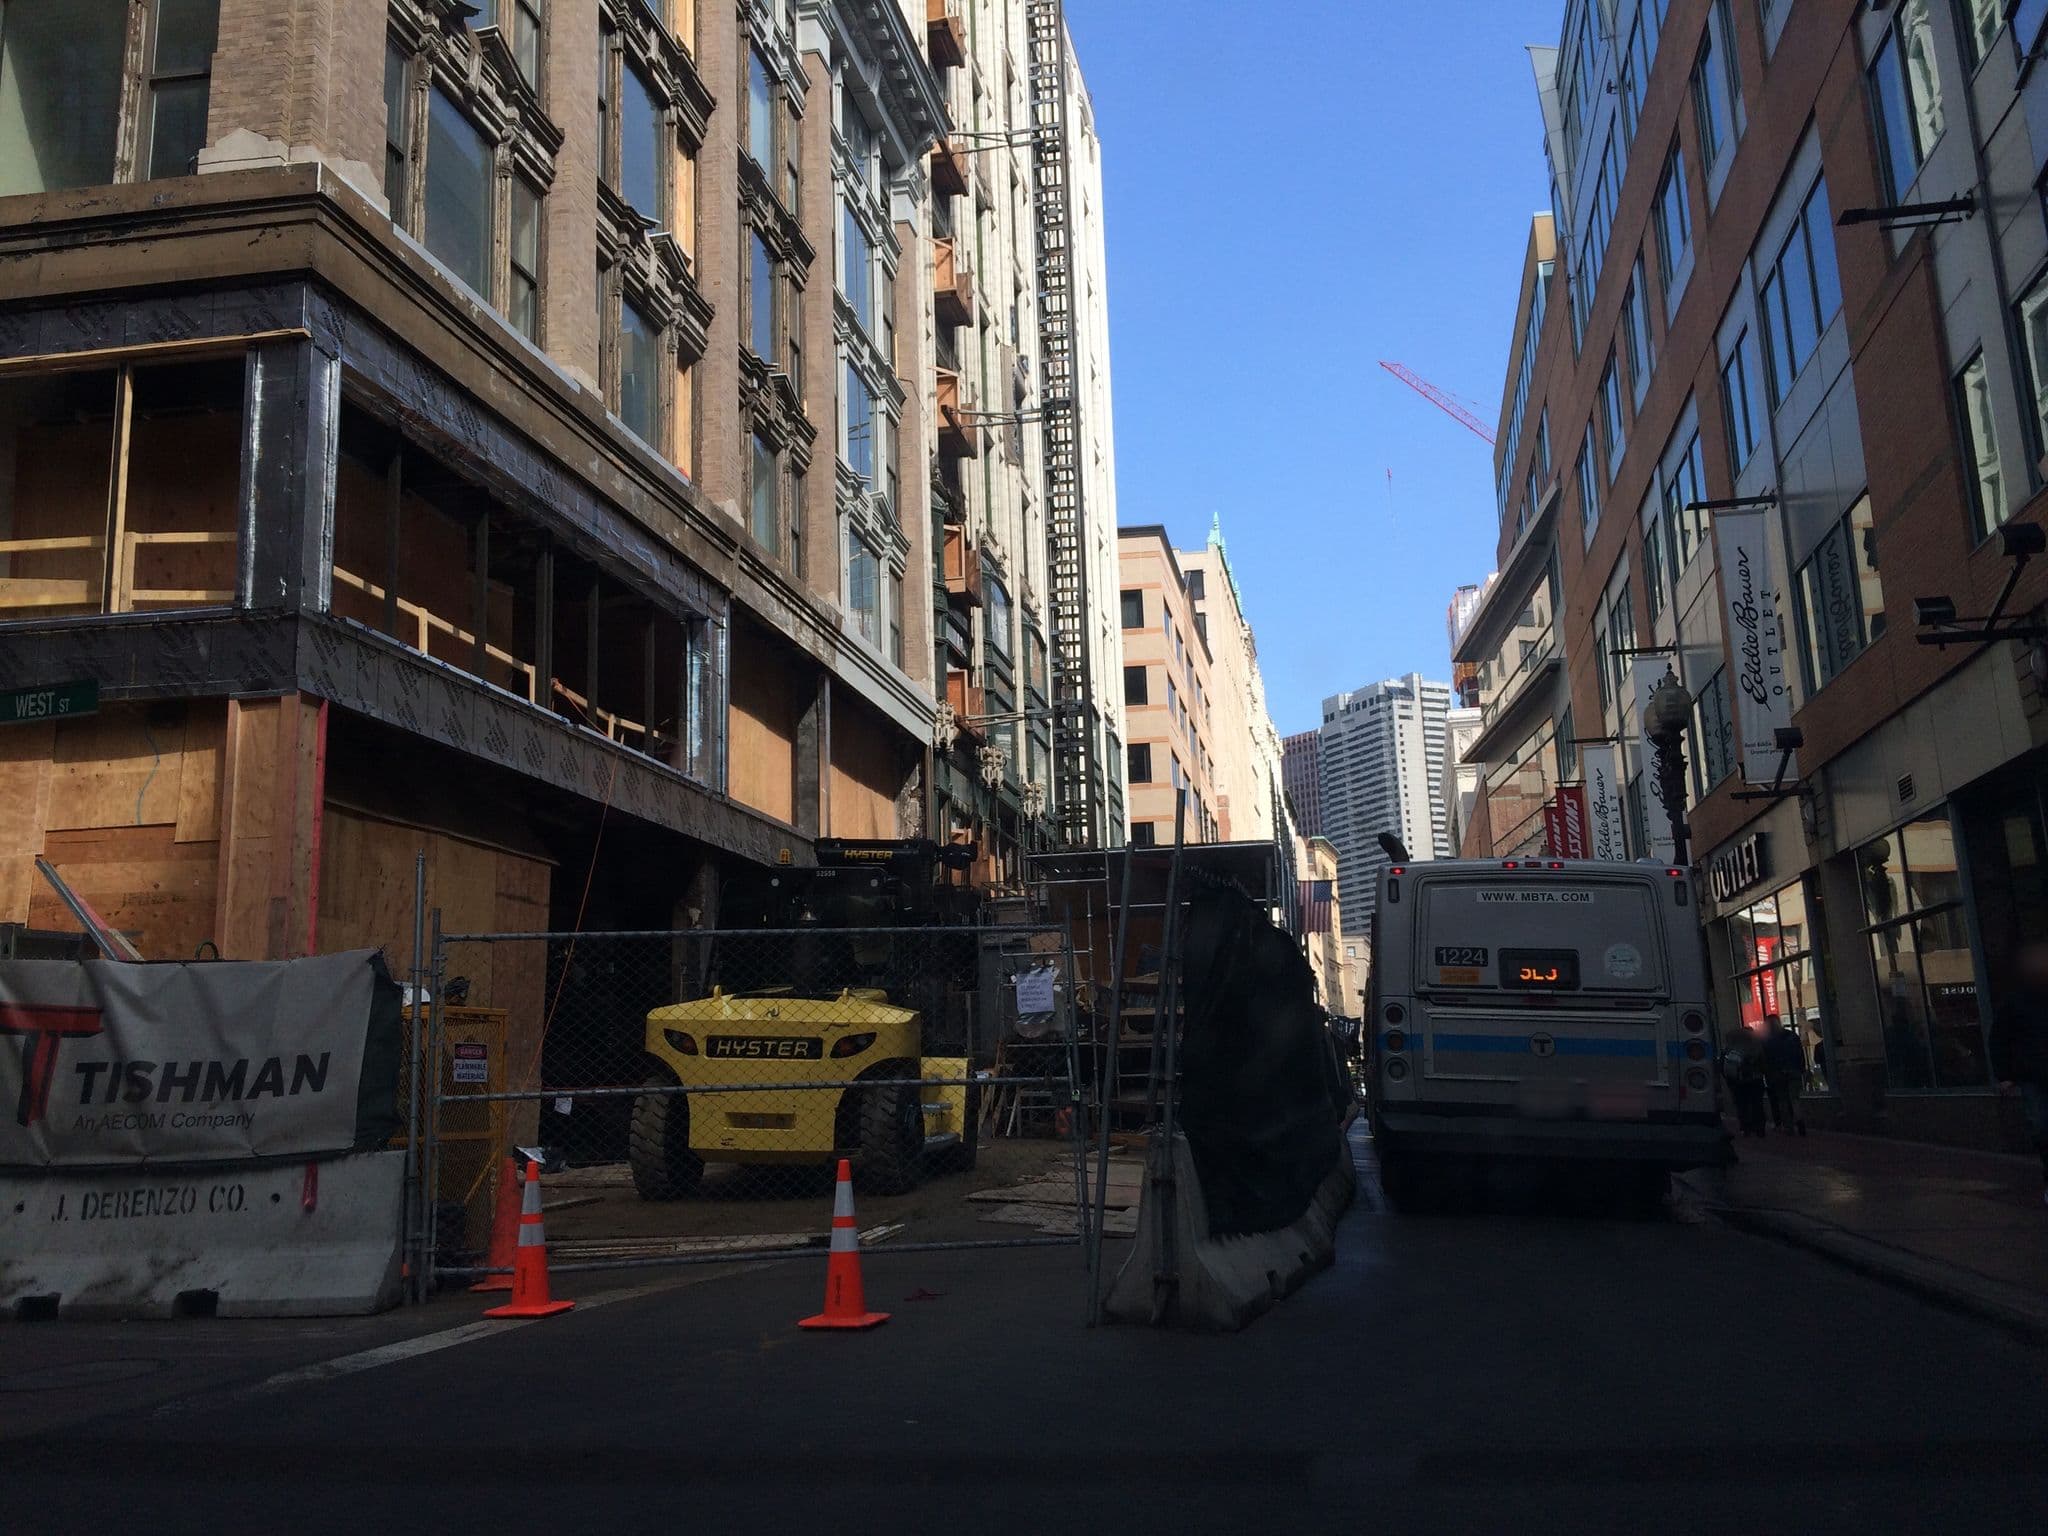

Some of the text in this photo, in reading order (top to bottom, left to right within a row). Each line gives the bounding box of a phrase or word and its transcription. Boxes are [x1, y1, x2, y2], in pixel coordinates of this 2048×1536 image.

[1760, 590, 1783, 696] OUTLET
[15, 691, 71, 718] WEST ST
[1609, 795, 1624, 860] OUTLET
[843, 849, 894, 860] HYSTER
[1709, 832, 1760, 903] OUTLET
[1438, 948, 1486, 965] 1224
[715, 1039, 809, 1057] HYSTER
[75, 1051, 331, 1105] TISHMAN
[73, 1111, 257, 1131] An AECOM Company
